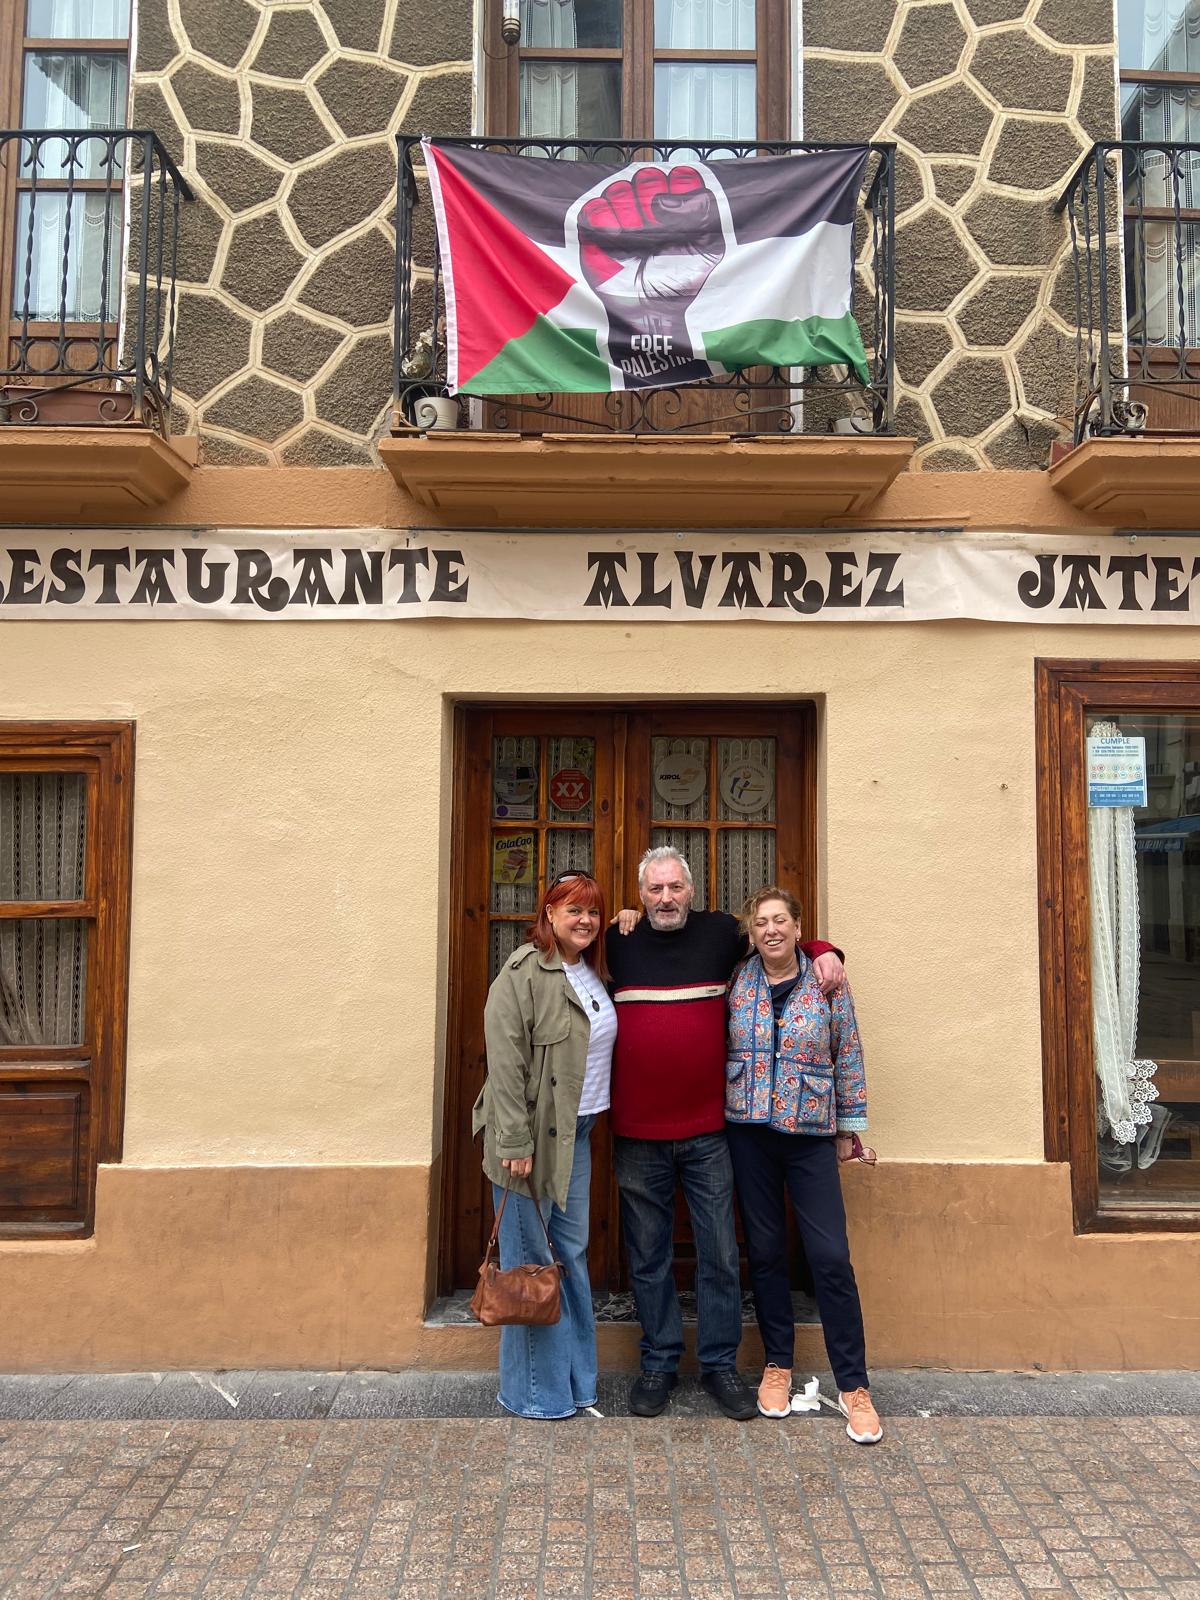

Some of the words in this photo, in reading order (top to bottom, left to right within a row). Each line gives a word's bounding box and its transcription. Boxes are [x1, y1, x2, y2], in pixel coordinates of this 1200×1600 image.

[0, 546, 470, 613] ESTAURANTE
[583, 550, 905, 614] ALVAREZ
[1017, 552, 1200, 612] JATE
[1100, 737, 1131, 745] CUMPLE
